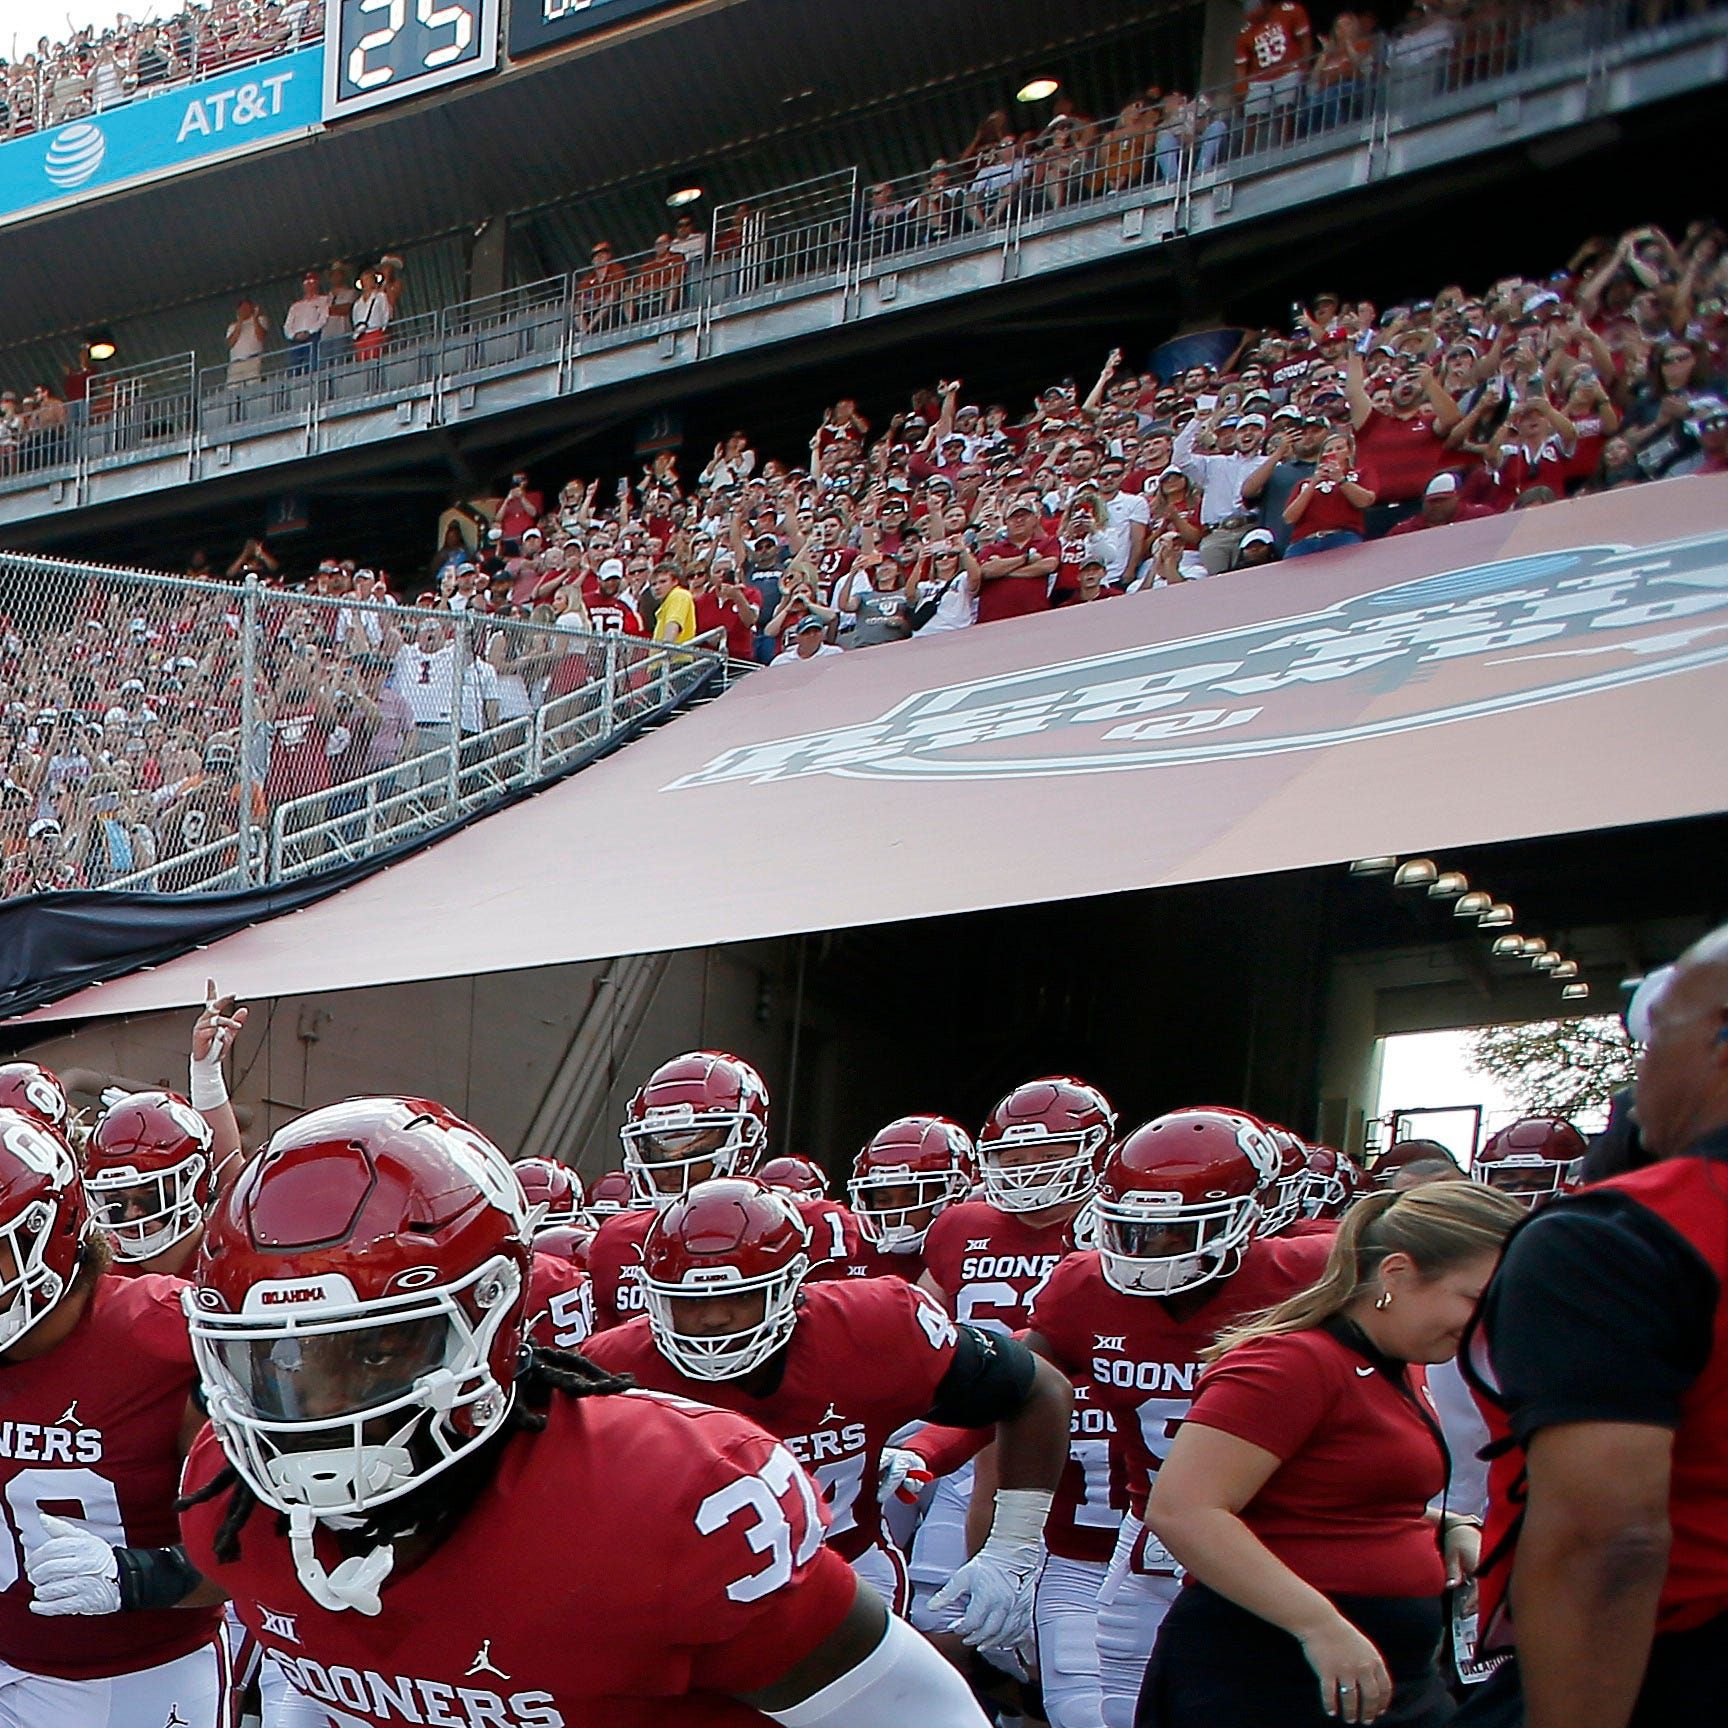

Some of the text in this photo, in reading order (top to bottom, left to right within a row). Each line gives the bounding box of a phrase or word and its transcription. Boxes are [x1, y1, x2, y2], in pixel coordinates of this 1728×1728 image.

[175, 72, 294, 143] AT&T
[1100, 706, 1264, 741] OU
[2, 1123, 75, 1187] OU
[261, 1286, 327, 1306] OKLAHOMA
[1093, 1356, 1206, 1392] SOON
[694, 1443, 828, 1603] 37
